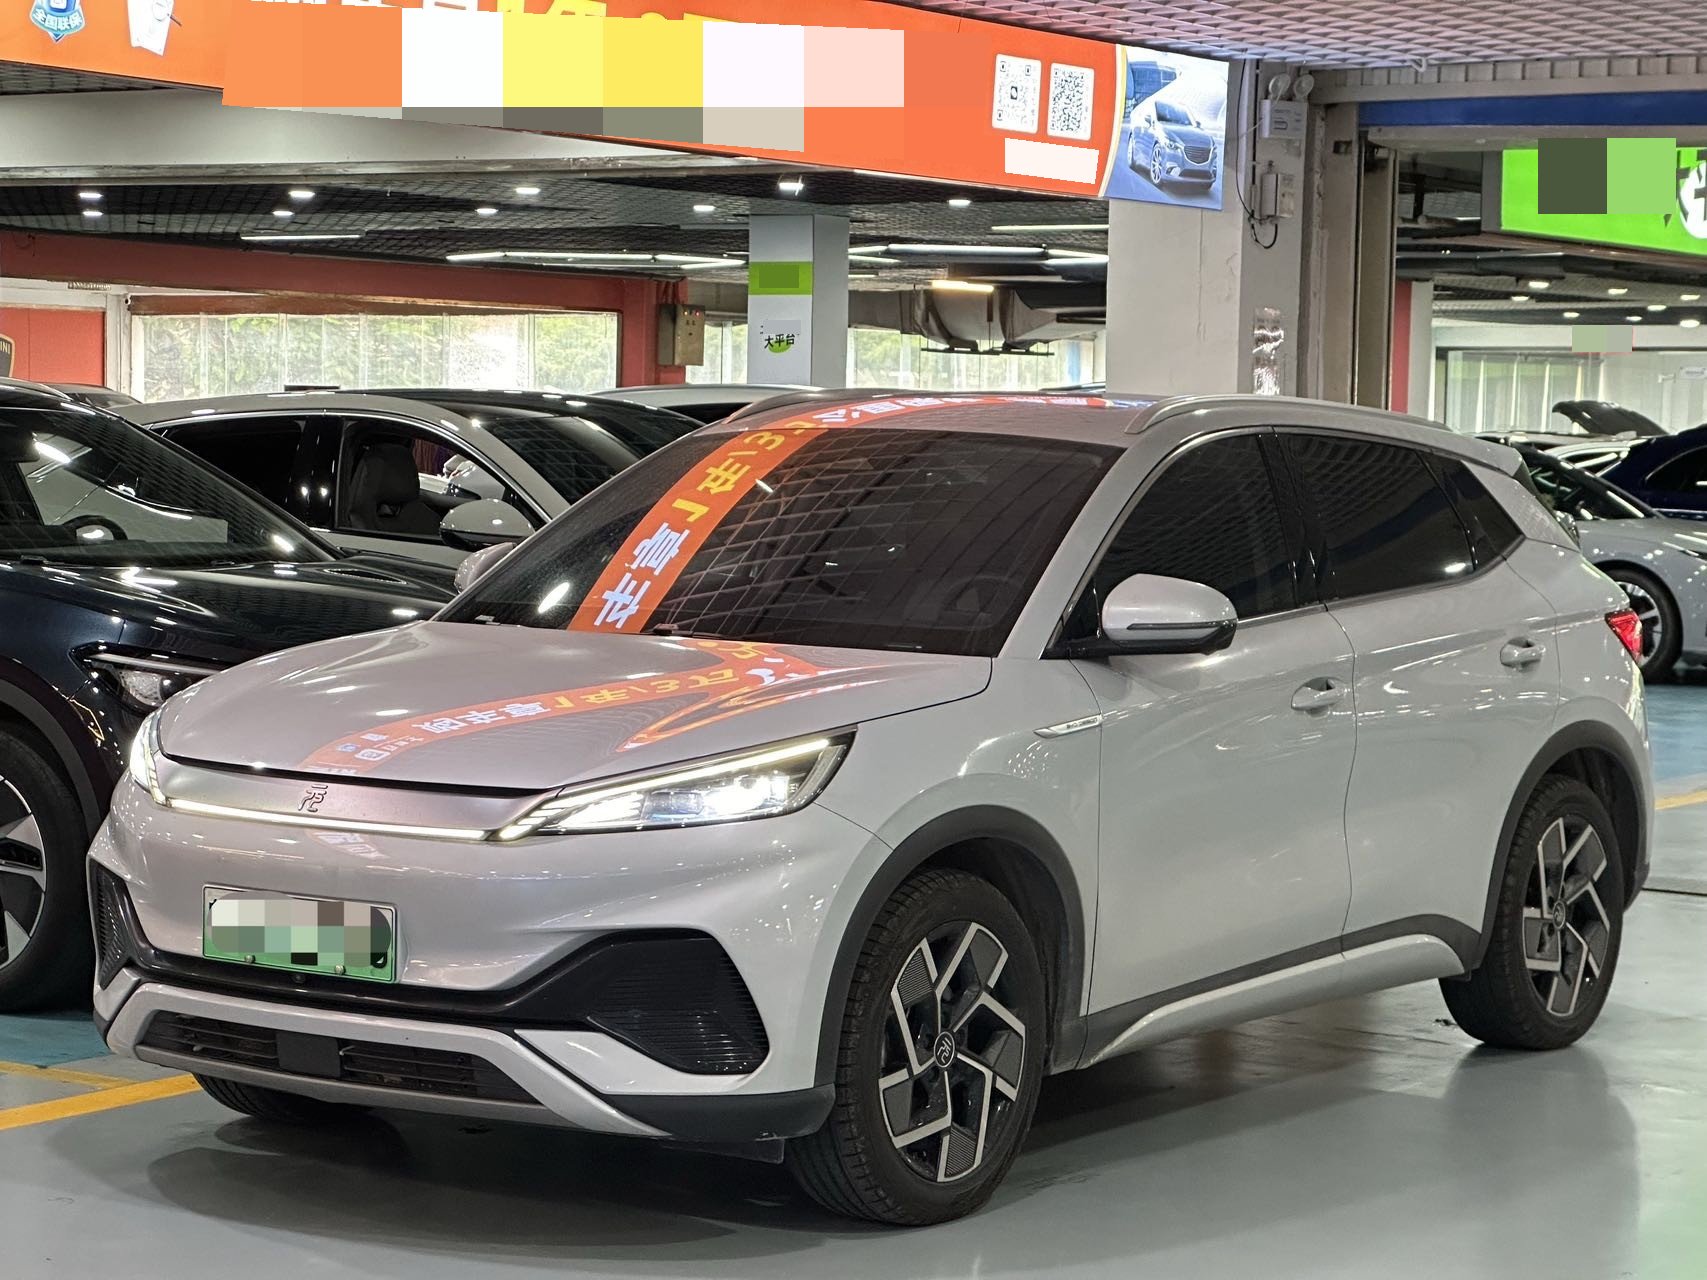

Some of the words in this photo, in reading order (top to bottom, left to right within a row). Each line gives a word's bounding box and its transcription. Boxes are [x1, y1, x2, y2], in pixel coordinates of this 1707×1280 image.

[32, 8, 83, 31] 全国联保
[764, 333, 795, 349] 大平台
